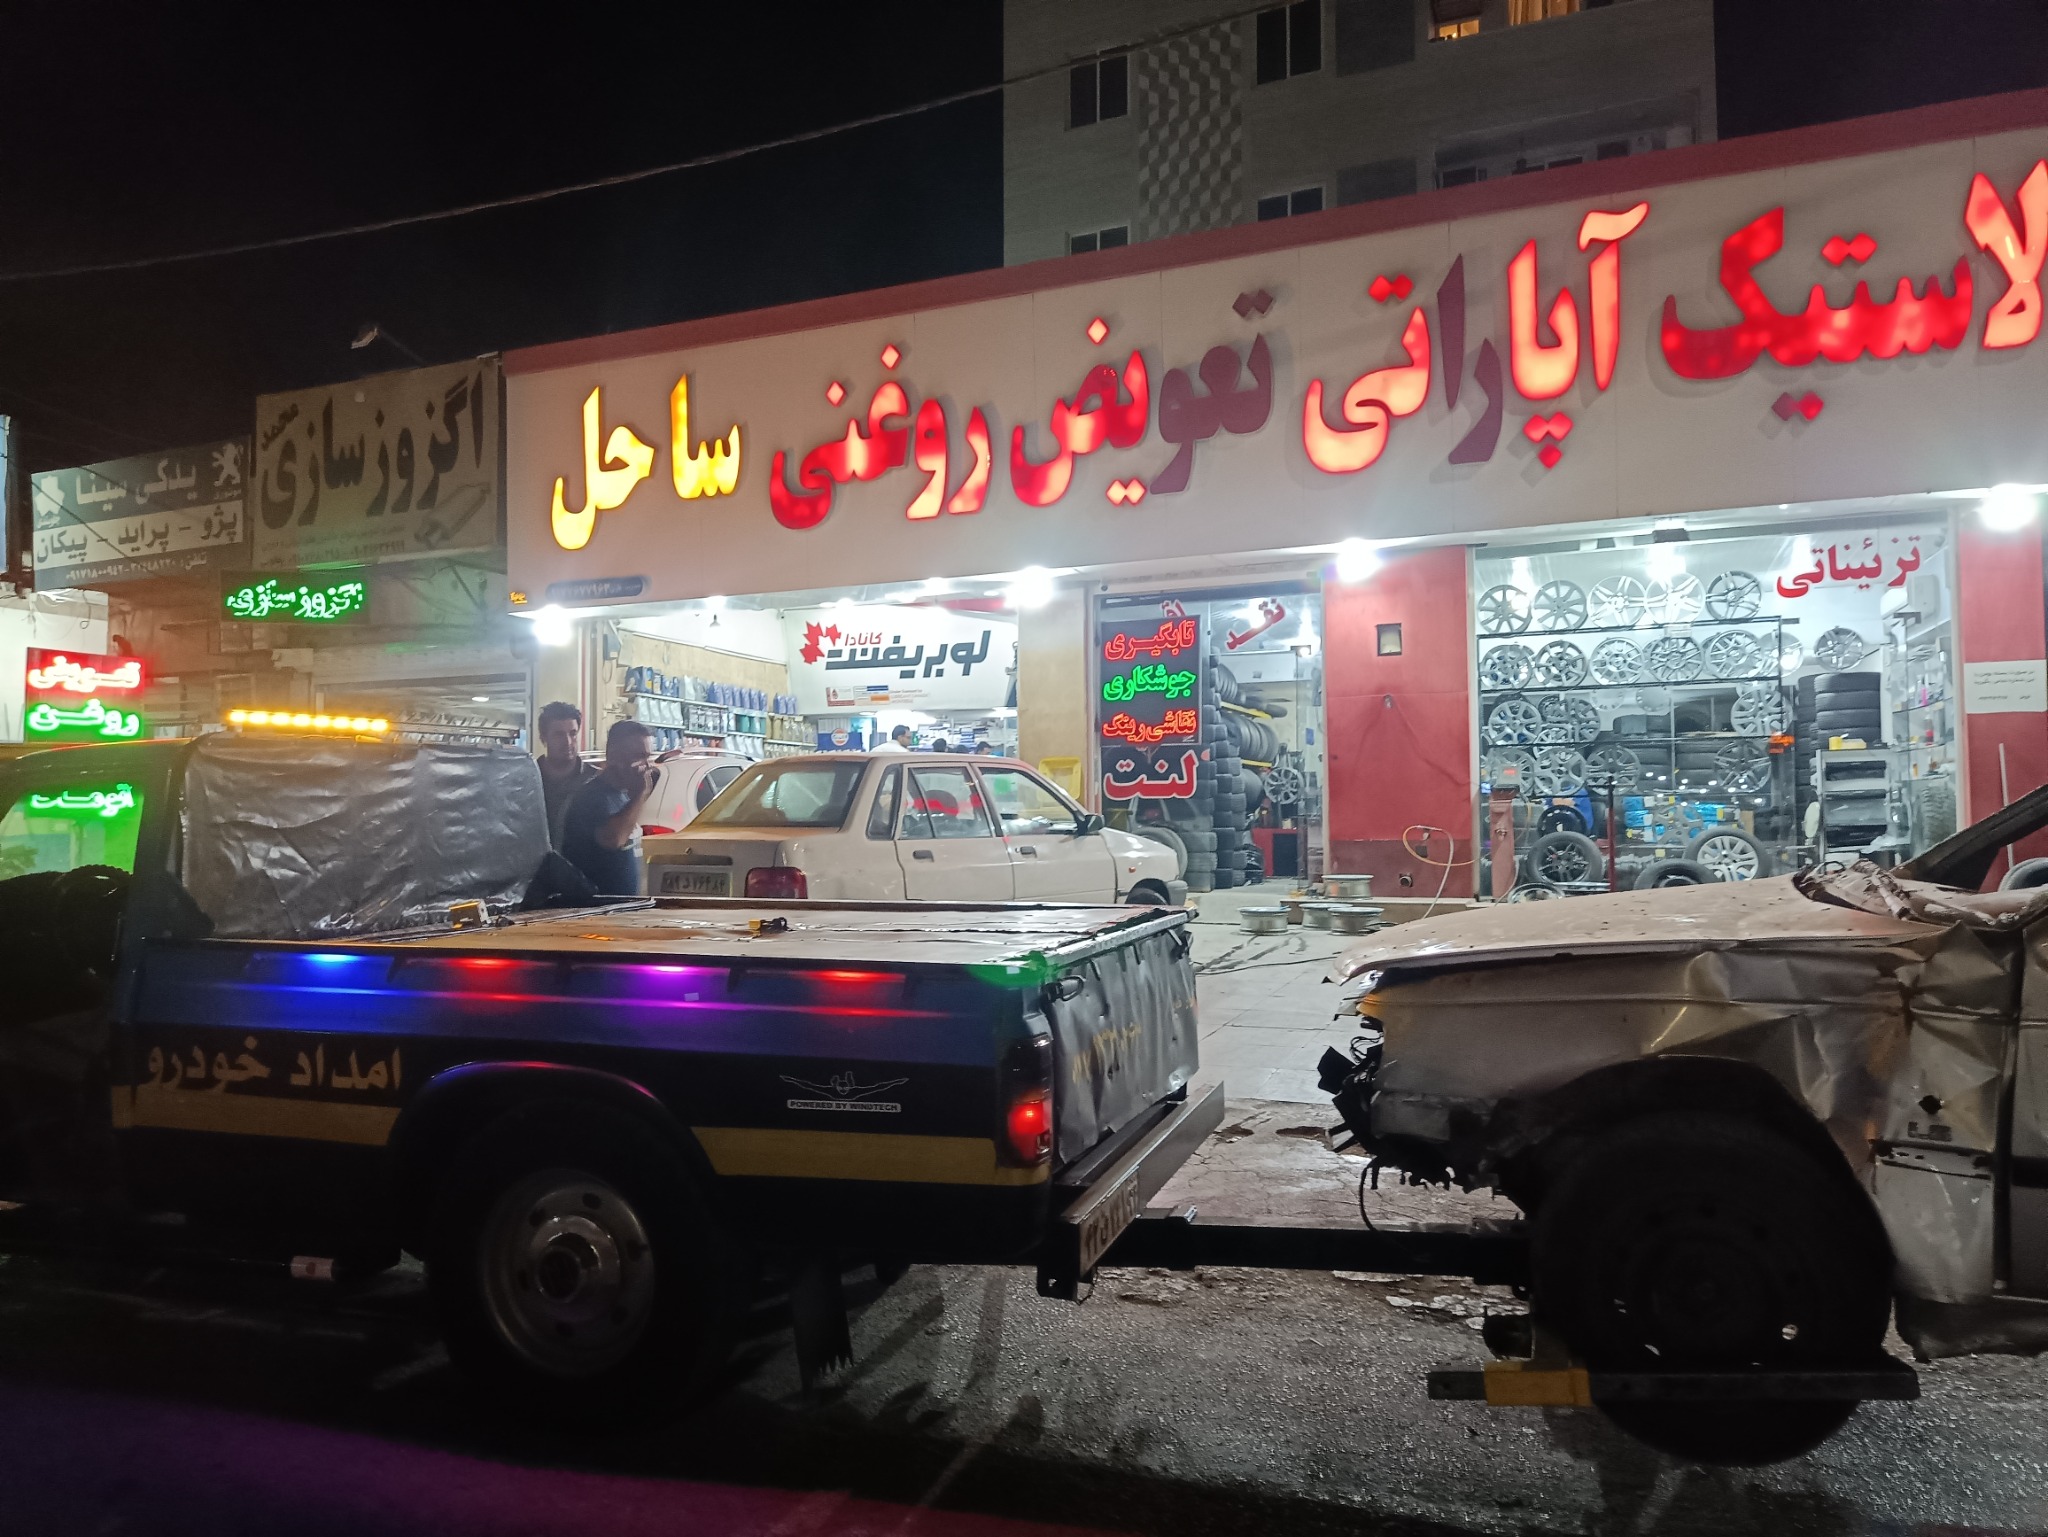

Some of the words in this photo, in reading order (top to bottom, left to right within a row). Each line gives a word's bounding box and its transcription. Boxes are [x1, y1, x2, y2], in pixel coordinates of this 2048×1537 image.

[1661, 159, 2048, 422] لاستیک
[1303, 202, 1650, 474] آپاراتی
[1010, 289, 1274, 507] تعویض
[770, 344, 991, 529] روغنی
[135, 457, 197, 505] یدکی
[551, 374, 741, 550] ساحل
[76, 472, 127, 511] سینا
[118, 519, 170, 554] پراید
[201, 504, 238, 543] پژو
[36, 529, 88, 564] پیکان
[1776, 535, 1921, 598] تزئیناتی
[825, 630, 991, 679] لوبریفنت
[844, 632, 883, 647] کانادا
[1104, 619, 1196, 661] تابگیری
[1103, 664, 1197, 701] جوشکاری
[29, 698, 140, 737] روغن
[1102, 712, 1147, 743] رینگ
[1145, 709, 1197, 742] نقاشی
[1103, 750, 1199, 801] لنت
[137, 1035, 271, 1094] خودرو
[289, 1042, 402, 1091] امداد
[789, 1100, 833, 1110] POWERED
[835, 1101, 848, 1110] BY
